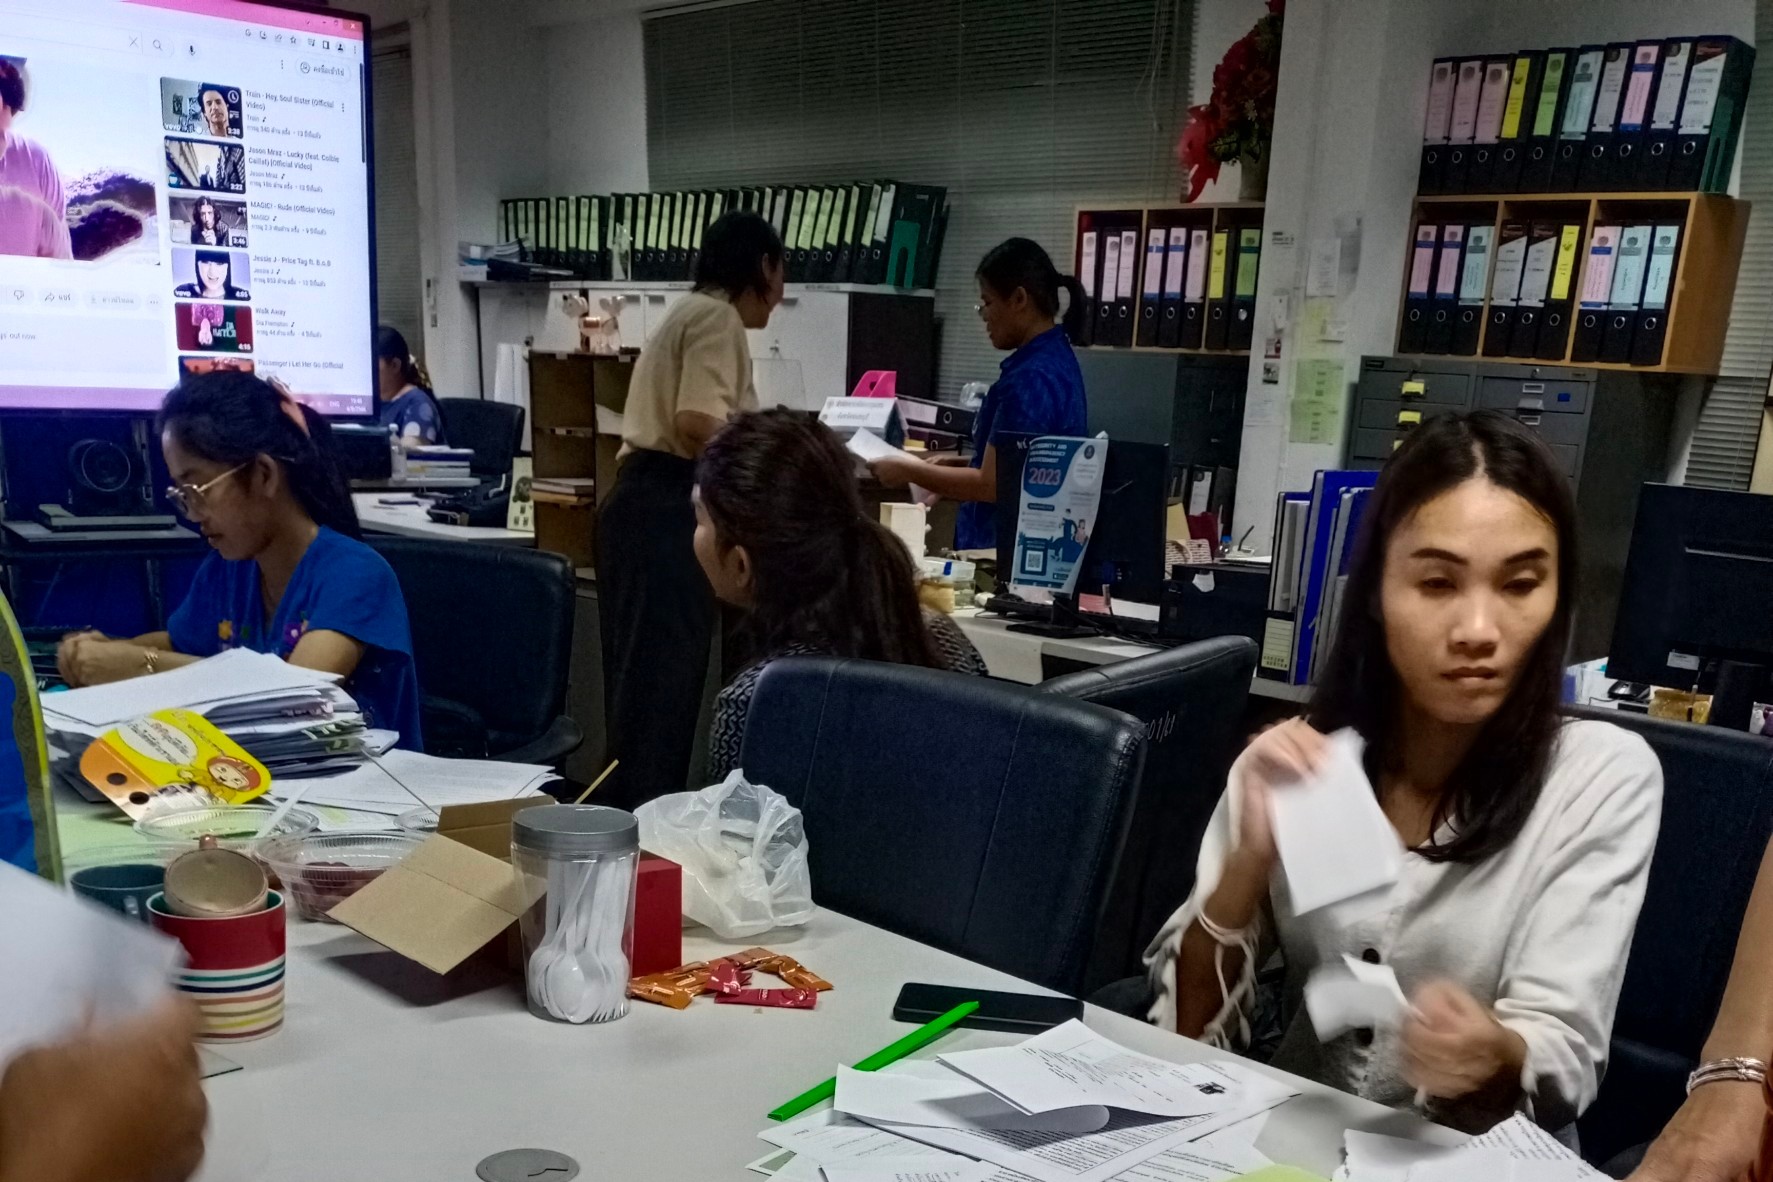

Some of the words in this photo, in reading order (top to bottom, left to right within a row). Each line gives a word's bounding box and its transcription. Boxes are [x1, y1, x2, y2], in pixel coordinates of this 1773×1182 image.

[246, 90, 260, 98] Train
[280, 94, 292, 102] Soul
[294, 96, 310, 104] Sister
[312, 99, 334, 108] (Official
[246, 102, 265, 110] Video)
[268, 148, 282, 156] Mraz
[287, 151, 304, 160] Lucky
[305, 152, 320, 161] (feat.
[294, 205, 316, 214] (Official
[317, 206, 335, 215] Video)
[281, 257, 296, 265] Price
[297, 258, 307, 266] Tag
[1029, 467, 1061, 486] 2023
